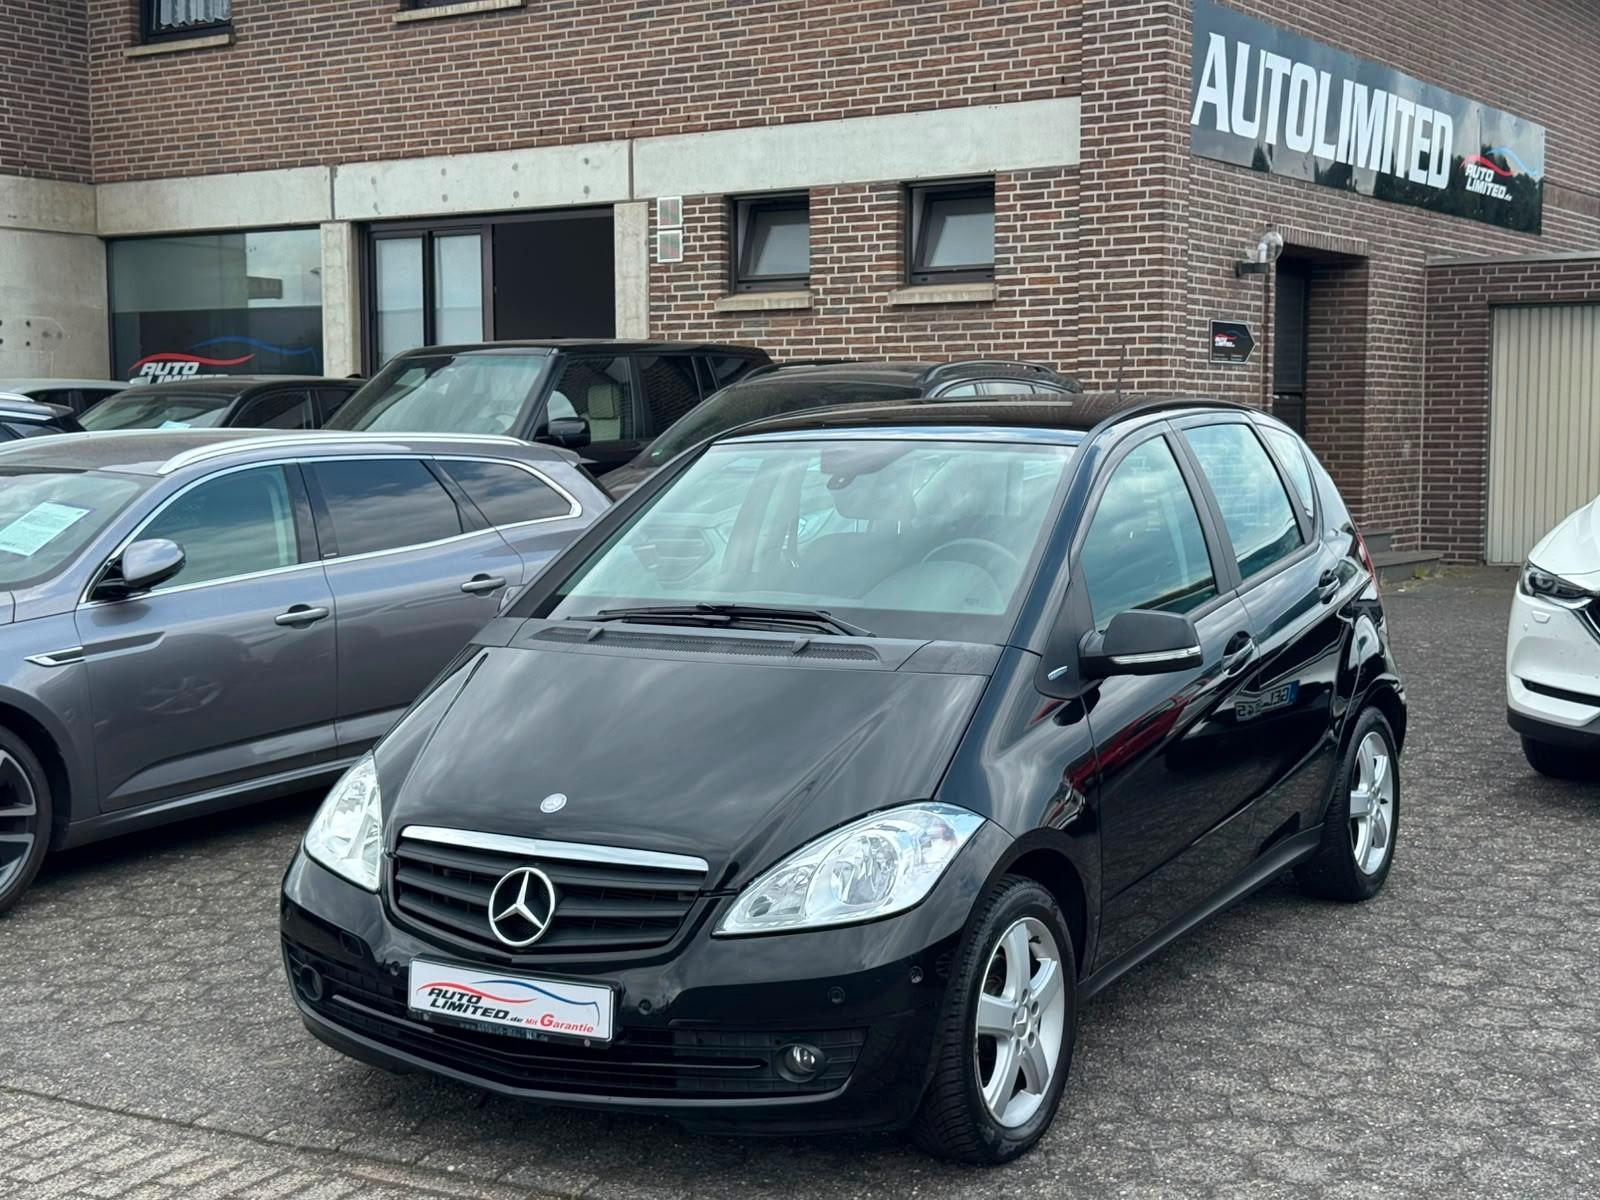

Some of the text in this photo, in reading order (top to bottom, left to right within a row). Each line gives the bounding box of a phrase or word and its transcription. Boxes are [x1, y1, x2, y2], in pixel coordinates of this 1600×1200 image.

[1190, 31, 1454, 190] AUTOLIMITED
[1465, 163, 1495, 182] AUTO
[139, 362, 200, 376] AUTO
[428, 987, 483, 1005] AUTO
[541, 1013, 595, 1034] Garantie
